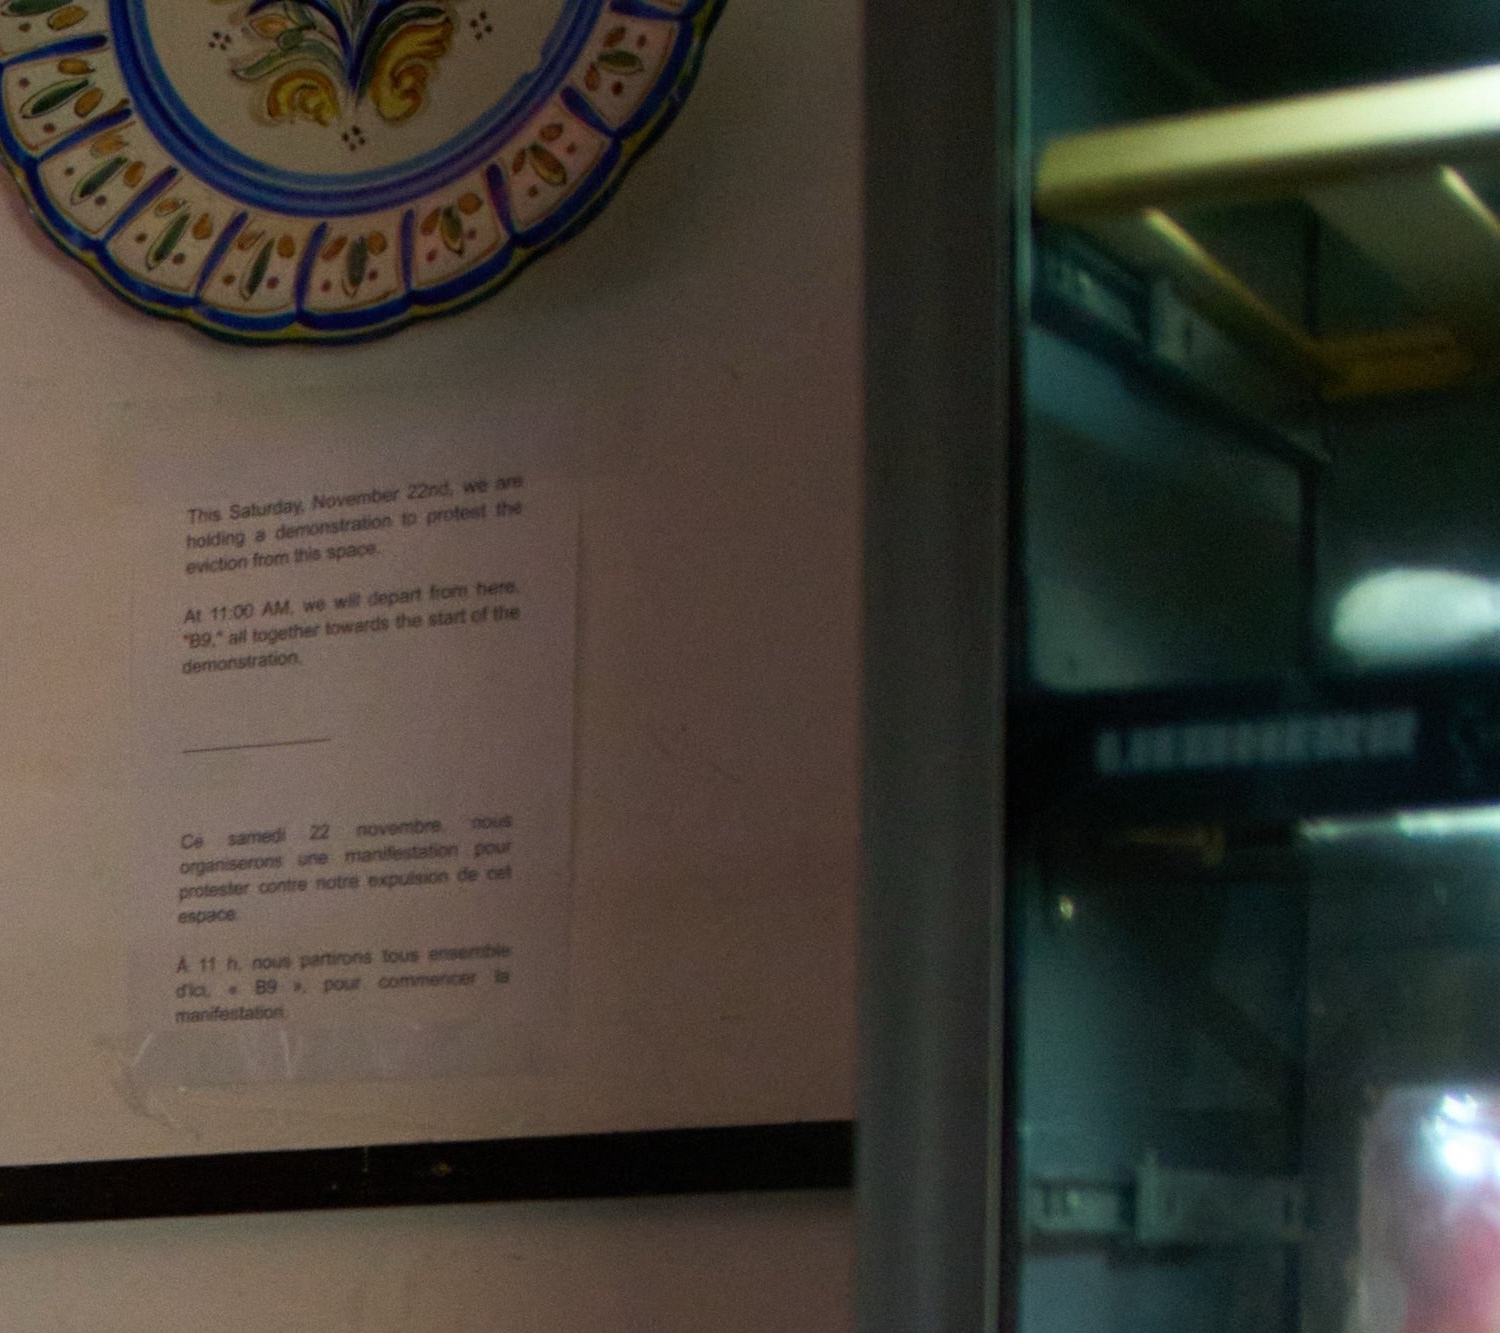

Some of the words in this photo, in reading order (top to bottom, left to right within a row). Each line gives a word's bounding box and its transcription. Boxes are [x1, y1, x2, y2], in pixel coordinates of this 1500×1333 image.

[187, 508, 221, 524] This
[312, 488, 399, 509] November
[463, 479, 488, 493] we
[186, 531, 245, 548] holding
[275, 515, 392, 540] demonstration
[401, 511, 417, 526] to
[426, 504, 486, 526] protest
[496, 501, 522, 517] the
[185, 556, 248, 574] eviction
[253, 552, 289, 567] from
[294, 546, 321, 563] this
[183, 608, 202, 624] At
[303, 598, 326, 612] we
[368, 587, 422, 606] depart
[429, 584, 468, 599] from
[228, 629, 247, 644] all
[253, 624, 320, 644] together
[326, 616, 389, 635] towards
[396, 613, 422, 628] the
[428, 609, 466, 626] start
[471, 607, 488, 623] of
[492, 606, 520, 621] the
[181, 833, 204, 849] Ce
[228, 827, 286, 846] samedi
[309, 823, 330, 840] 22
[474, 841, 512, 858] pour
[258, 878, 308, 894] contre
[316, 876, 359, 889] notre
[457, 867, 478, 882] de
[200, 956, 216, 971] 11
[252, 956, 291, 970] nous
[382, 949, 419, 963] tous
[255, 979, 278, 995] B9
[323, 978, 361, 993] pour
